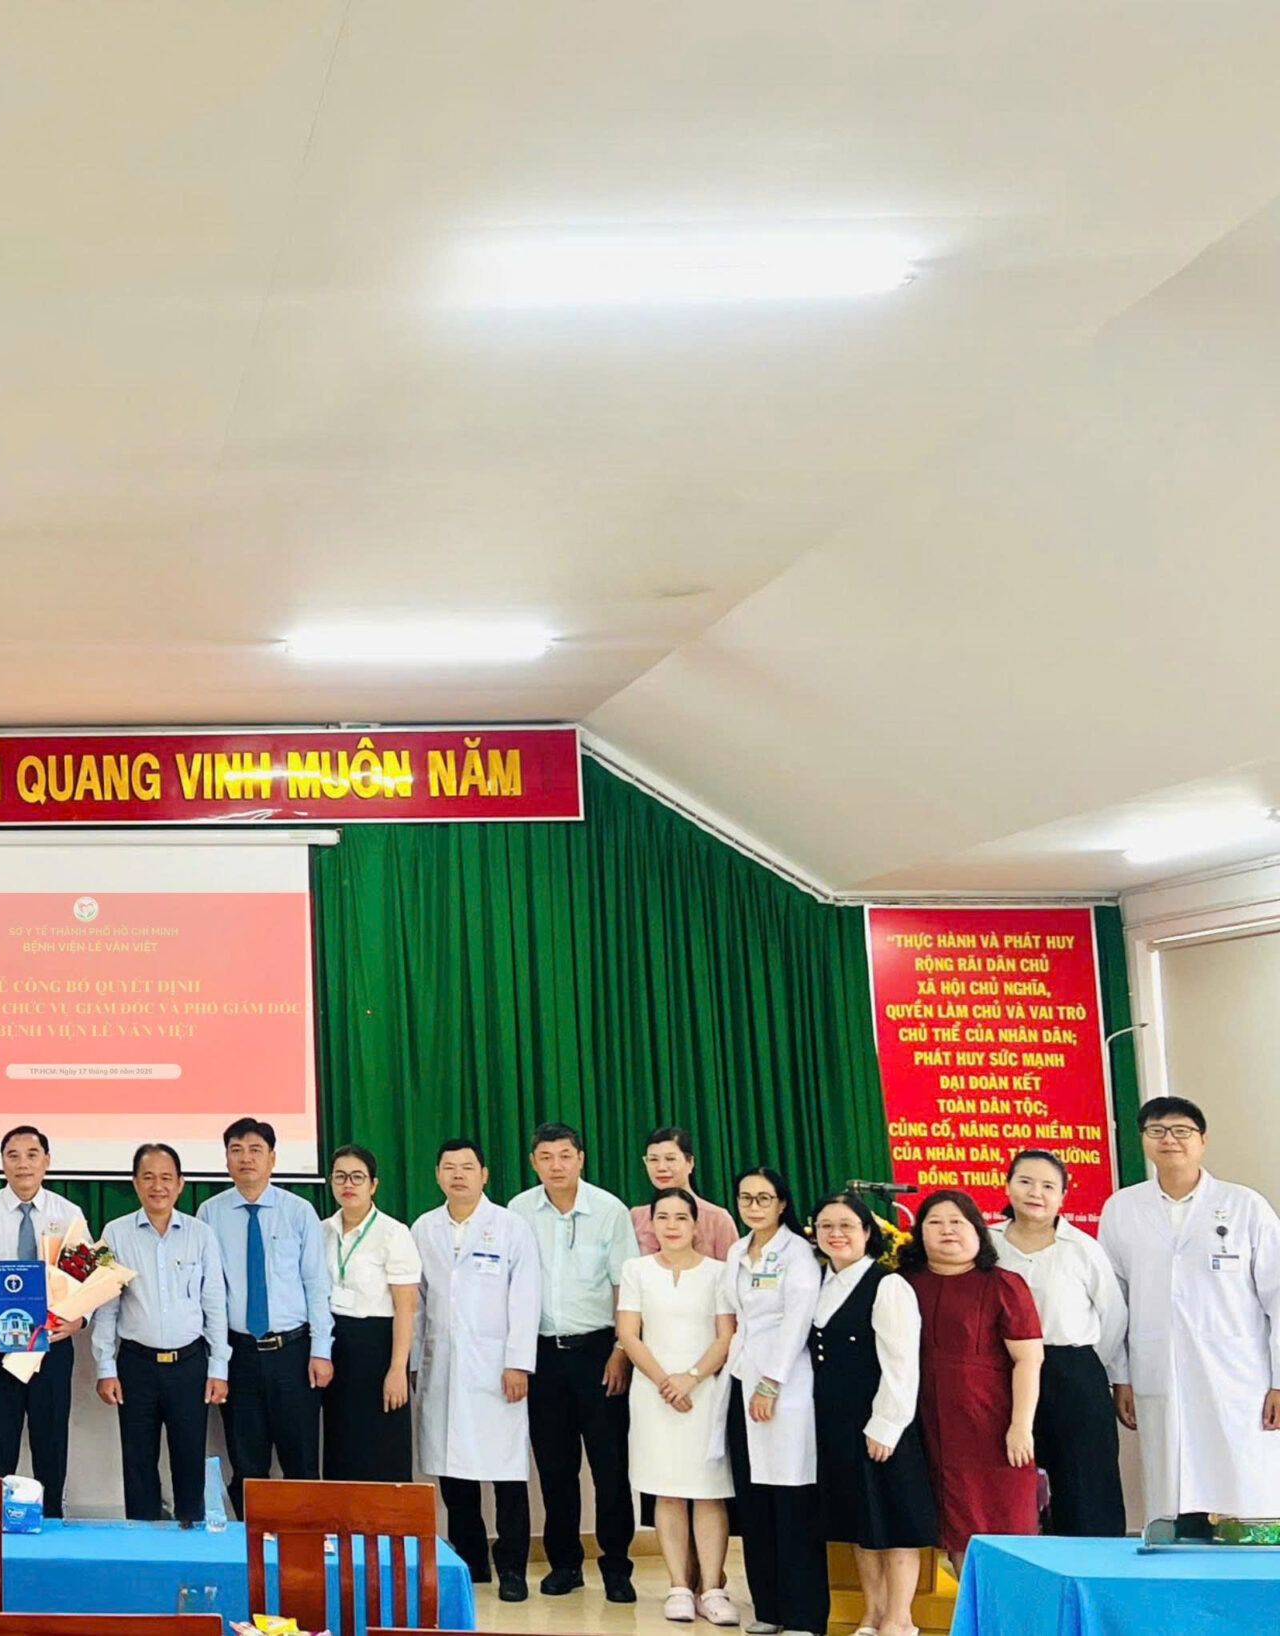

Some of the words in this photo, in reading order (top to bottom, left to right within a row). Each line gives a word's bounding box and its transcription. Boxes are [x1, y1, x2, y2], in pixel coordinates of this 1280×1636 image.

[17, 753, 160, 804] QUANG
[176, 752, 274, 799] VINH
[285, 737, 415, 800] MUÔN
[428, 737, 521, 797] NĂM
[887, 934, 932, 951] “THỰC
[937, 932, 976, 948] HÀNH
[981, 932, 999, 948] VÀ
[1004, 935, 1040, 948] PHÁT
[1047, 936, 1073, 949] HUY
[915, 954, 954, 974] RỘNG
[958, 955, 982, 971] RÃI
[987, 955, 1016, 971] DÂN
[1020, 954, 1049, 972] CHỦ
[917, 978, 936, 994] XÃ
[941, 978, 966, 997] HỘI
[970, 977, 999, 995] CHỦ
[1004, 979, 1051, 998] NGHĨA,
[886, 999, 934, 1020] QUYỀN
[938, 1002, 969, 1018] LÀM
[972, 1000, 1001, 1019] CHỦ
[1006, 1002, 1025, 1019] VÀ
[1030, 1006, 1053, 1019] VAI
[1057, 1004, 1086, 1020] TRÒ
[899, 1023, 927, 1042] CHỦ
[932, 1021, 960, 1042] THỂ
[965, 1023, 995, 1042] CỦA
[999, 1026, 1038, 1042] NHÂN
[1043, 1027, 1076, 1045] DÂN;
[915, 1048, 951, 1065] PHÁT
[956, 1052, 984, 1066] HUY
[989, 1049, 1018, 1066] SỨC
[1022, 1053, 1064, 1069] MẠNH
[940, 1076, 965, 1091] ĐẠI
[969, 1073, 1009, 1090] ĐOÀN
[1013, 1072, 1041, 1090] KẾT
[938, 1096, 976, 1113] TOÀN
[980, 1097, 1010, 1114] DÂN
[1014, 1097, 1047, 1117] TỘC;
[888, 1118, 928, 1136] CỦNG
[931, 1118, 955, 1139] CỐ,
[960, 1120, 999, 1137] NÂNG
[1003, 1124, 1031, 1138] CAO
[1036, 1120, 1073, 1139] NIỀM
[1077, 1126, 1101, 1139] TIN
[893, 1141, 922, 1160] CỦA
[926, 1144, 966, 1161] NHÂN
[970, 1144, 1004, 1164] DÂN,
[1053, 1145, 1100, 1164] CƯỜNG
[918, 1165, 958, 1185] ĐỒNG
